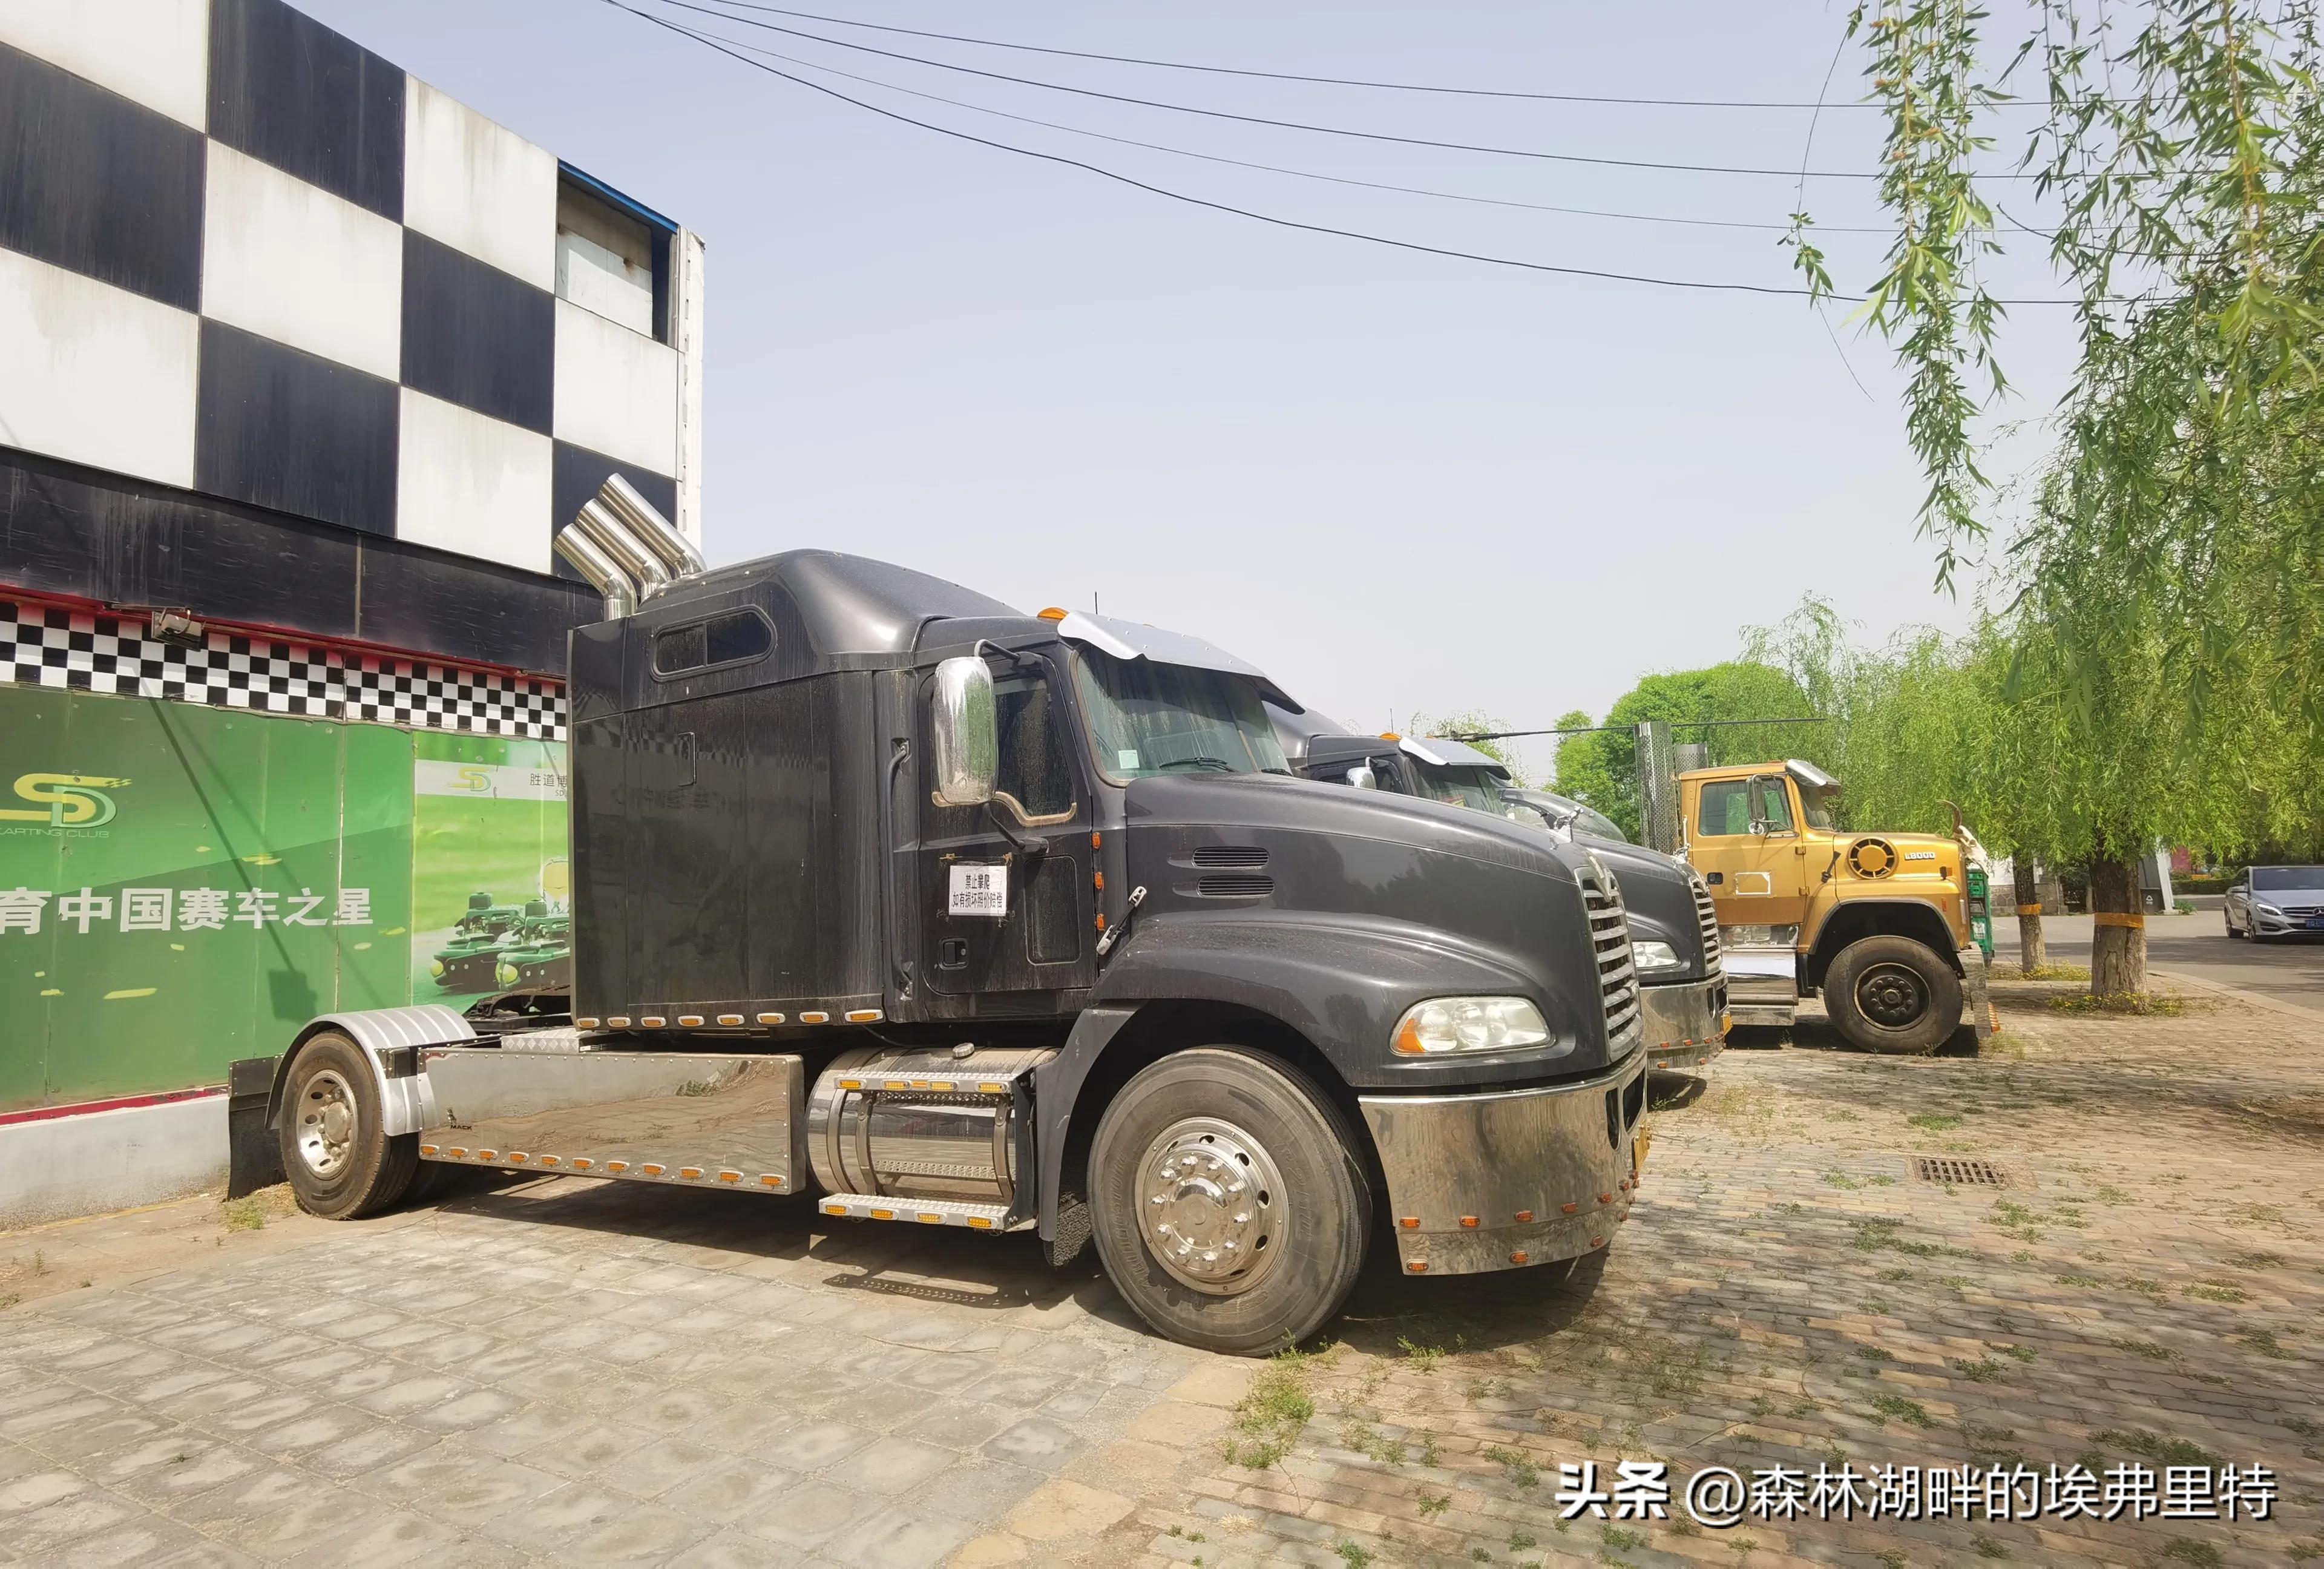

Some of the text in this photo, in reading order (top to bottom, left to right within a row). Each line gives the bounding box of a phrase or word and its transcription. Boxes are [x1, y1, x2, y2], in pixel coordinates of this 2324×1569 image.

[66, 829, 110, 838] CLUB
[952, 891, 1003, 909] 如有损坏照价赔偿
[0, 887, 373, 935] 育中国赛车之星
